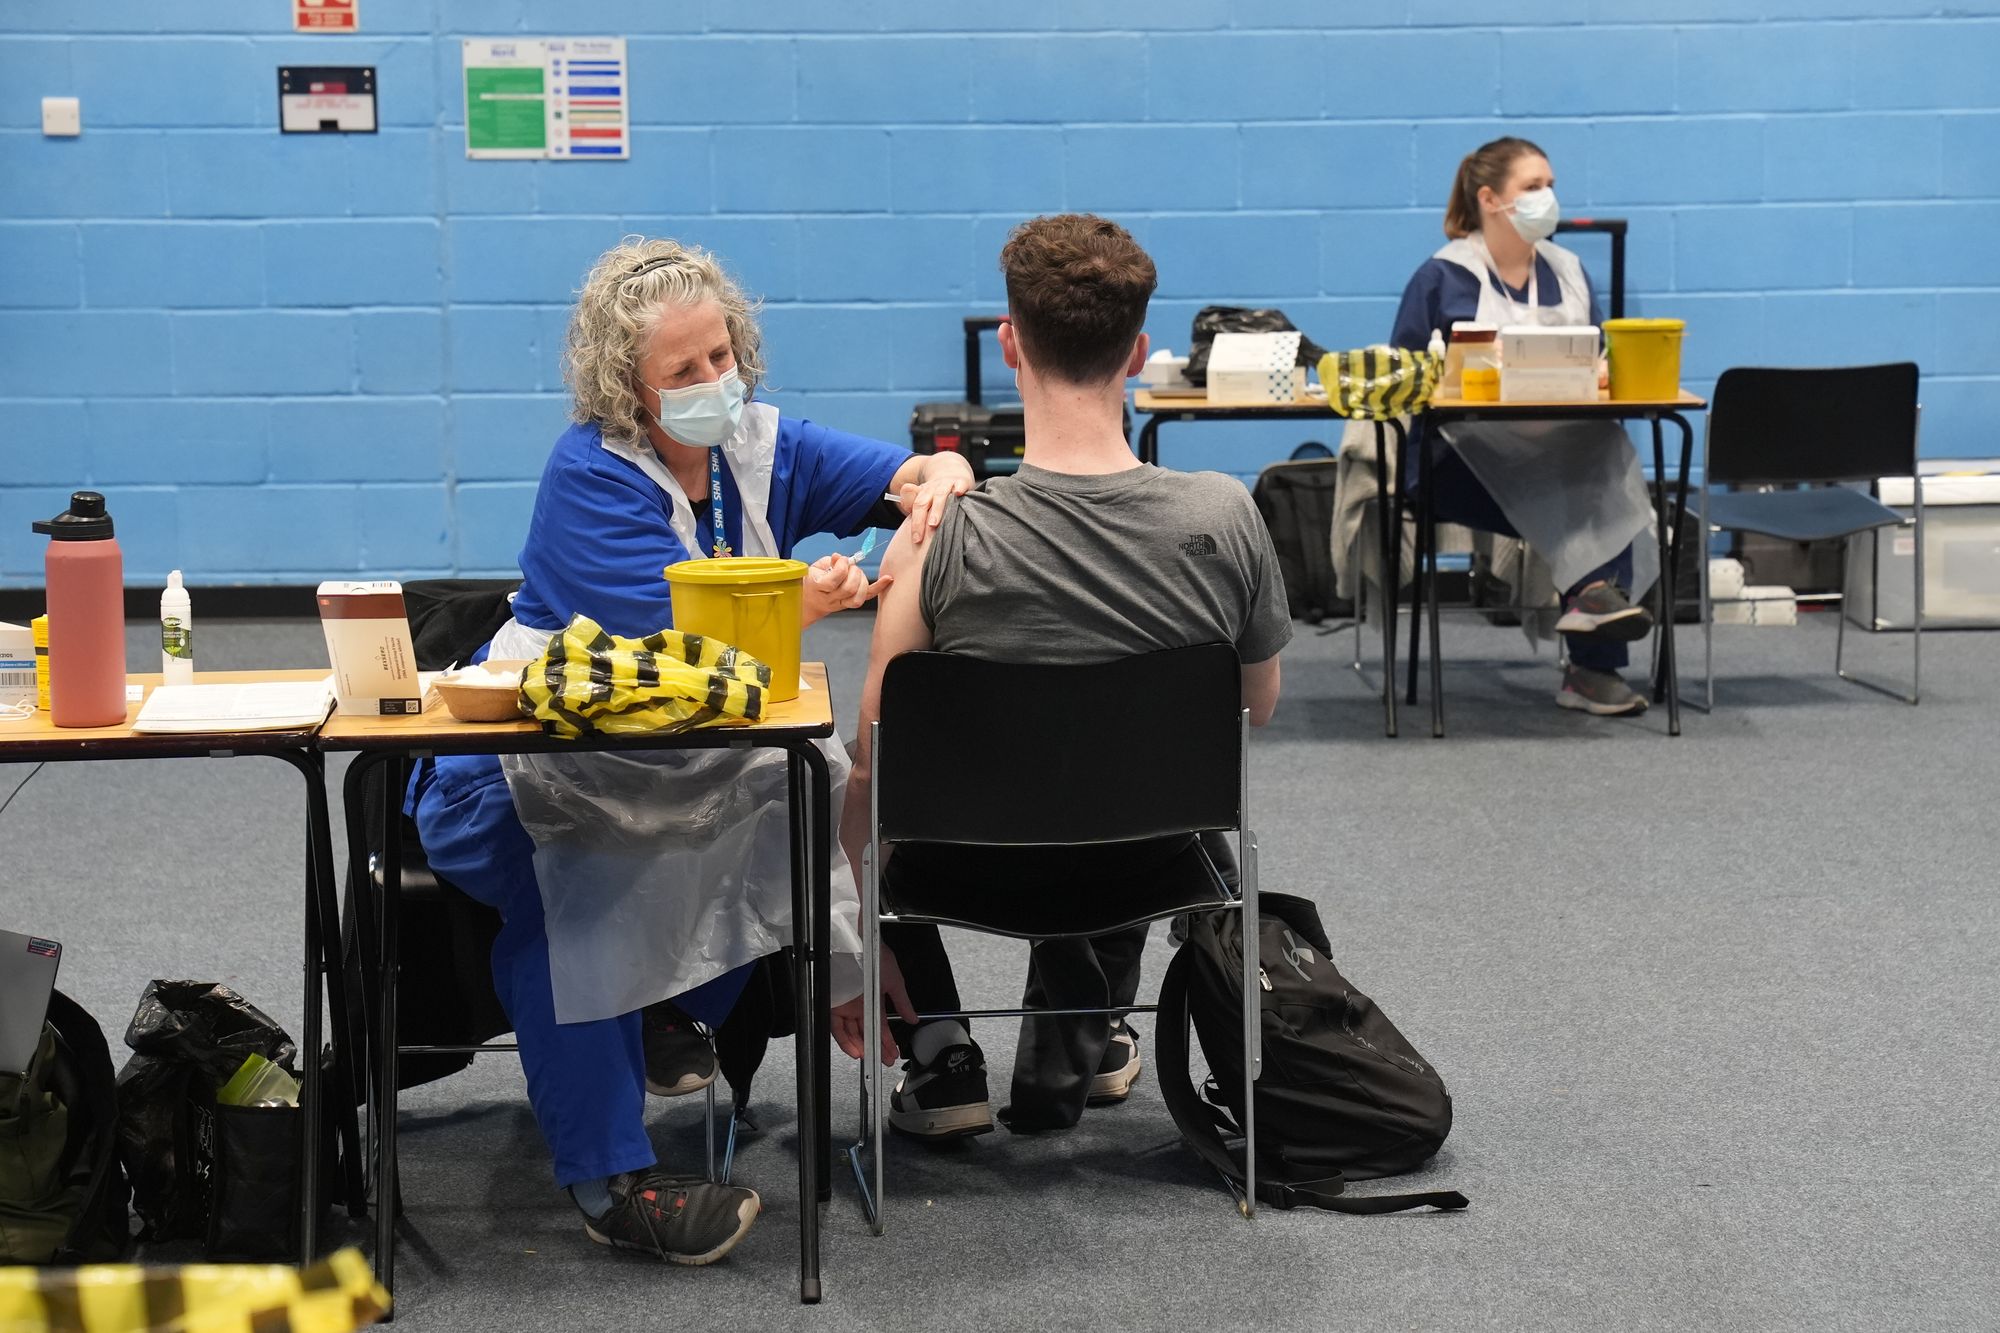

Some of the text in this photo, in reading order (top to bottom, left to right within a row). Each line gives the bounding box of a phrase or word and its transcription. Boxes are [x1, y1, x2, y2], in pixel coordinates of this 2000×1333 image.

[711, 452, 720, 473] NHS
[712, 480, 722, 501] NHS
[713, 508, 724, 529] NHS
[1189, 534, 1204, 542] THE
[1178, 542, 1204, 550] NORTH
[1185, 549, 1204, 557] FACE
[950, 1051, 966, 1062] NIKE
[951, 1064, 970, 1074] AIR
